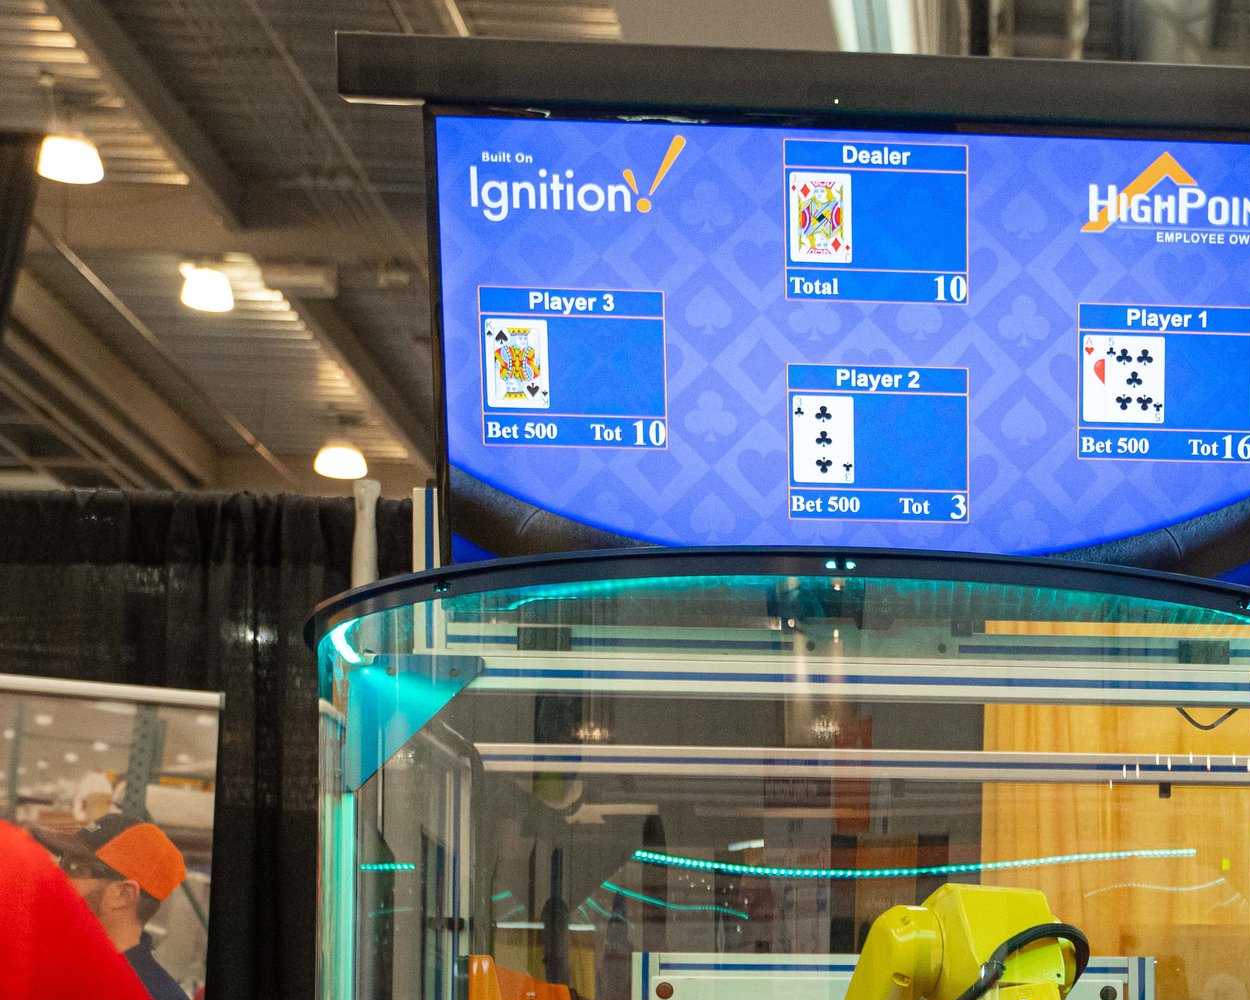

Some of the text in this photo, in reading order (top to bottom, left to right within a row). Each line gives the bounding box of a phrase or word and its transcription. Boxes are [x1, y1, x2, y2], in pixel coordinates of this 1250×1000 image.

[481, 151, 533, 164] Built On
[842, 146, 911, 166] Dealer
[1155, 231, 1226, 246] EMPLOYEE
[789, 275, 968, 302] Total 10
[528, 291, 615, 315] Player 3
[485, 321, 493, 329] K
[1126, 309, 1209, 331] Player 1
[1085, 336, 1115, 347] A 5
[835, 369, 921, 392] Player 2
[796, 397, 803, 407] 3
[486, 420, 667, 447] Bet 500 Tot 10
[1080, 437, 1112, 454] Bet
[1117, 438, 1150, 455] 500
[1188, 439, 1219, 458] Tot
[790, 494, 968, 521] Bet 500 Tot 3
